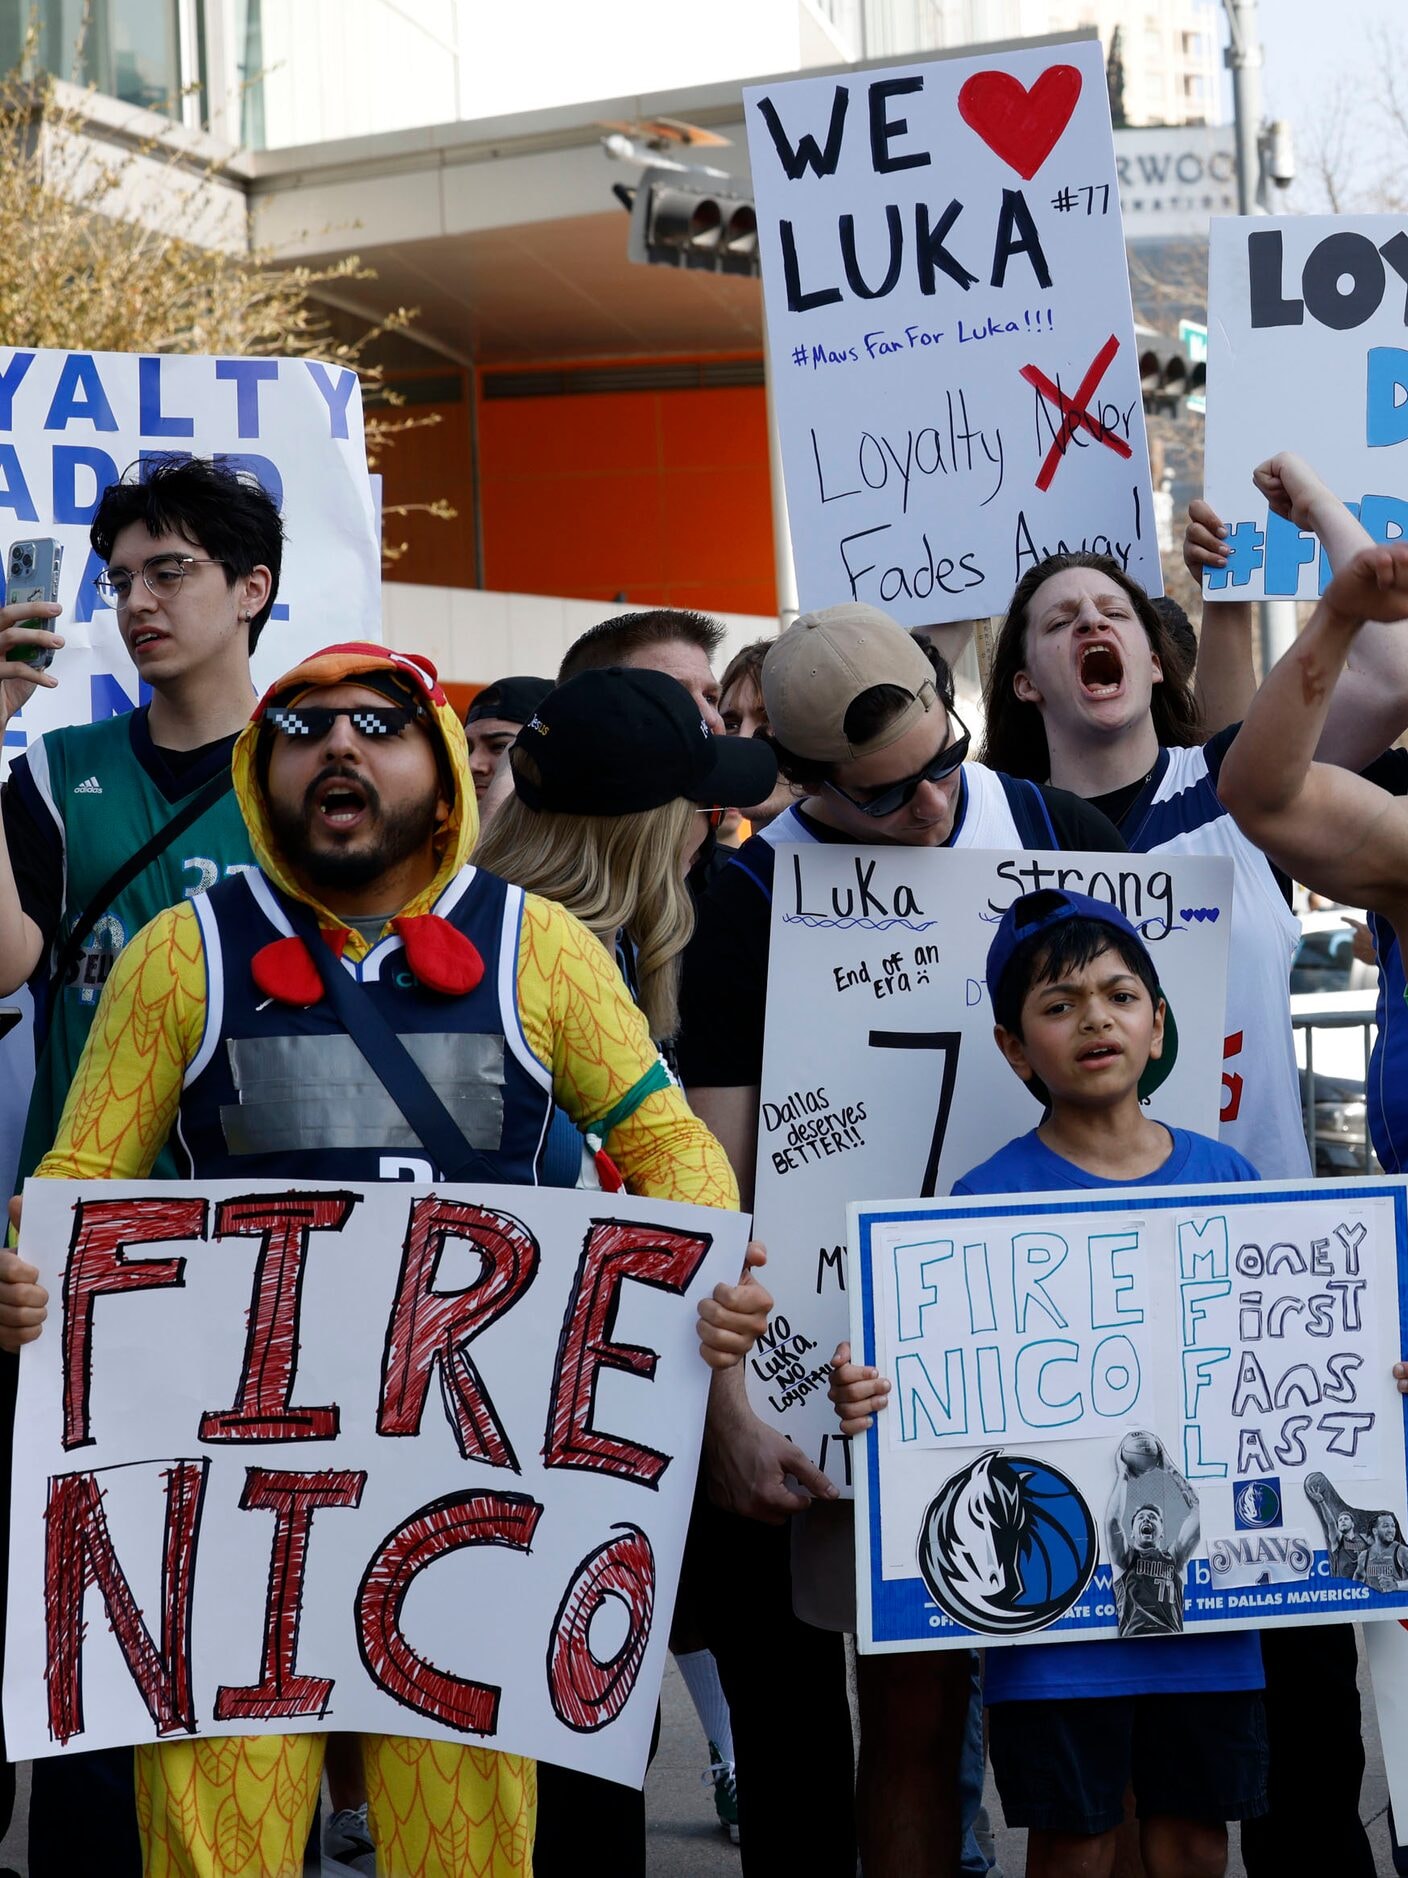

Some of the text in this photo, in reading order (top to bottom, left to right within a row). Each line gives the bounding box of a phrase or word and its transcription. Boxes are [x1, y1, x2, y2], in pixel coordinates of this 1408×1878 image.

[757, 75, 931, 179] WE
[779, 184, 1110, 312] LUKA #77
[957, 309, 1054, 343] Luka!!!
[811, 389, 1003, 514] Loyalty
[840, 524, 985, 602] Fades
[74, 786, 102, 795] adidas
[833, 944, 939, 992] End of an
[762, 1087, 829, 1132] Dallas
[787, 1101, 867, 1146] deserves
[772, 1125, 866, 1175] BETTER!!
[894, 1231, 1145, 1342] FIRE
[61, 1189, 713, 1490] FIRE
[756, 1315, 791, 1354] NO
[776, 1363, 805, 1394] NO
[896, 1335, 1141, 1442] NICO
[1136, 1558, 1174, 1580] DALLAS
[1211, 1535, 1313, 1575] MAVS
[43, 1456, 656, 1744] NICO
[1153, 1578, 1175, 1604] 77
[1197, 1597, 1224, 1610] THE
[1228, 1593, 1283, 1609] DALLAS
[1287, 1587, 1370, 1604] MAVERICKS
